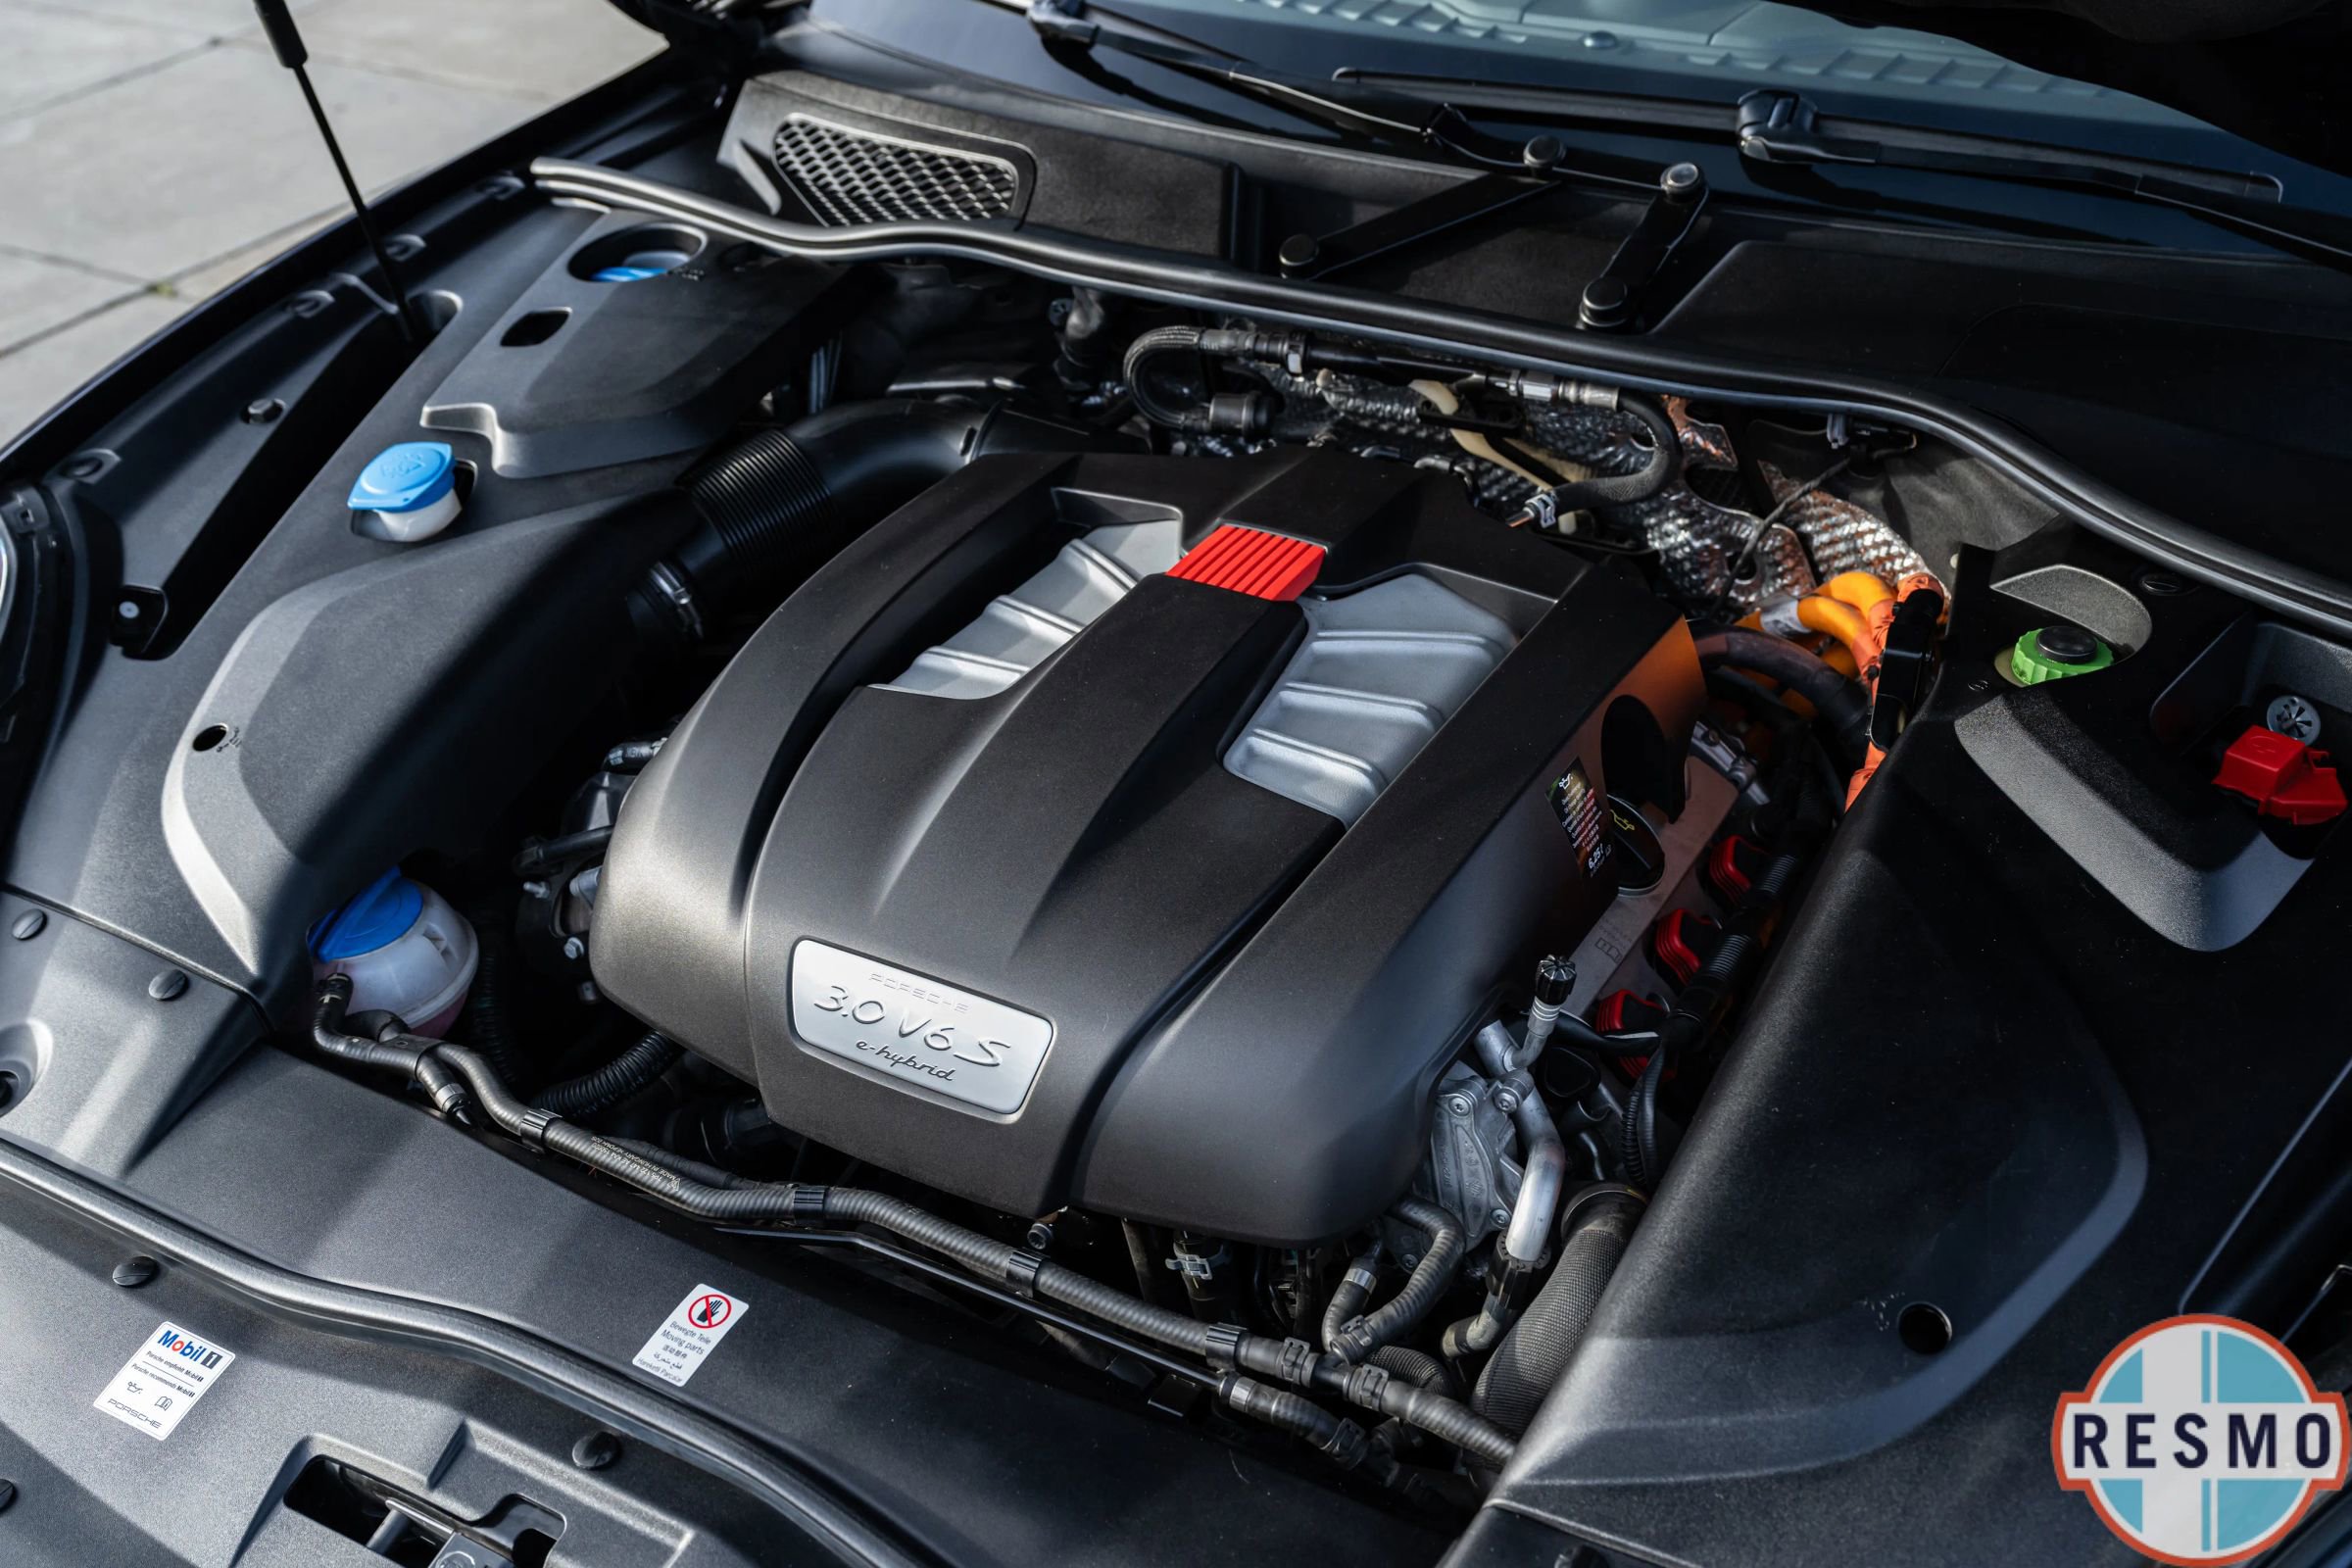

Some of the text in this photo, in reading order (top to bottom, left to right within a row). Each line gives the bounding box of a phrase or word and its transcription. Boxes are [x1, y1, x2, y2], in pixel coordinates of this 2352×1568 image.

[869, 972, 970, 1013] PORSCHE
[813, 985, 1011, 1067] 3.0 V6 S
[855, 1039, 956, 1082] e-hybrid
[625, 1152, 652, 1168] HUNGARY
[659, 1169, 677, 1181] MADE
[157, 1330, 207, 1362] Mobil
[661, 1329, 705, 1355] Moving parts
[669, 1320, 710, 1345] Bewegte Teile
[107, 1398, 163, 1429] PORSCHE
